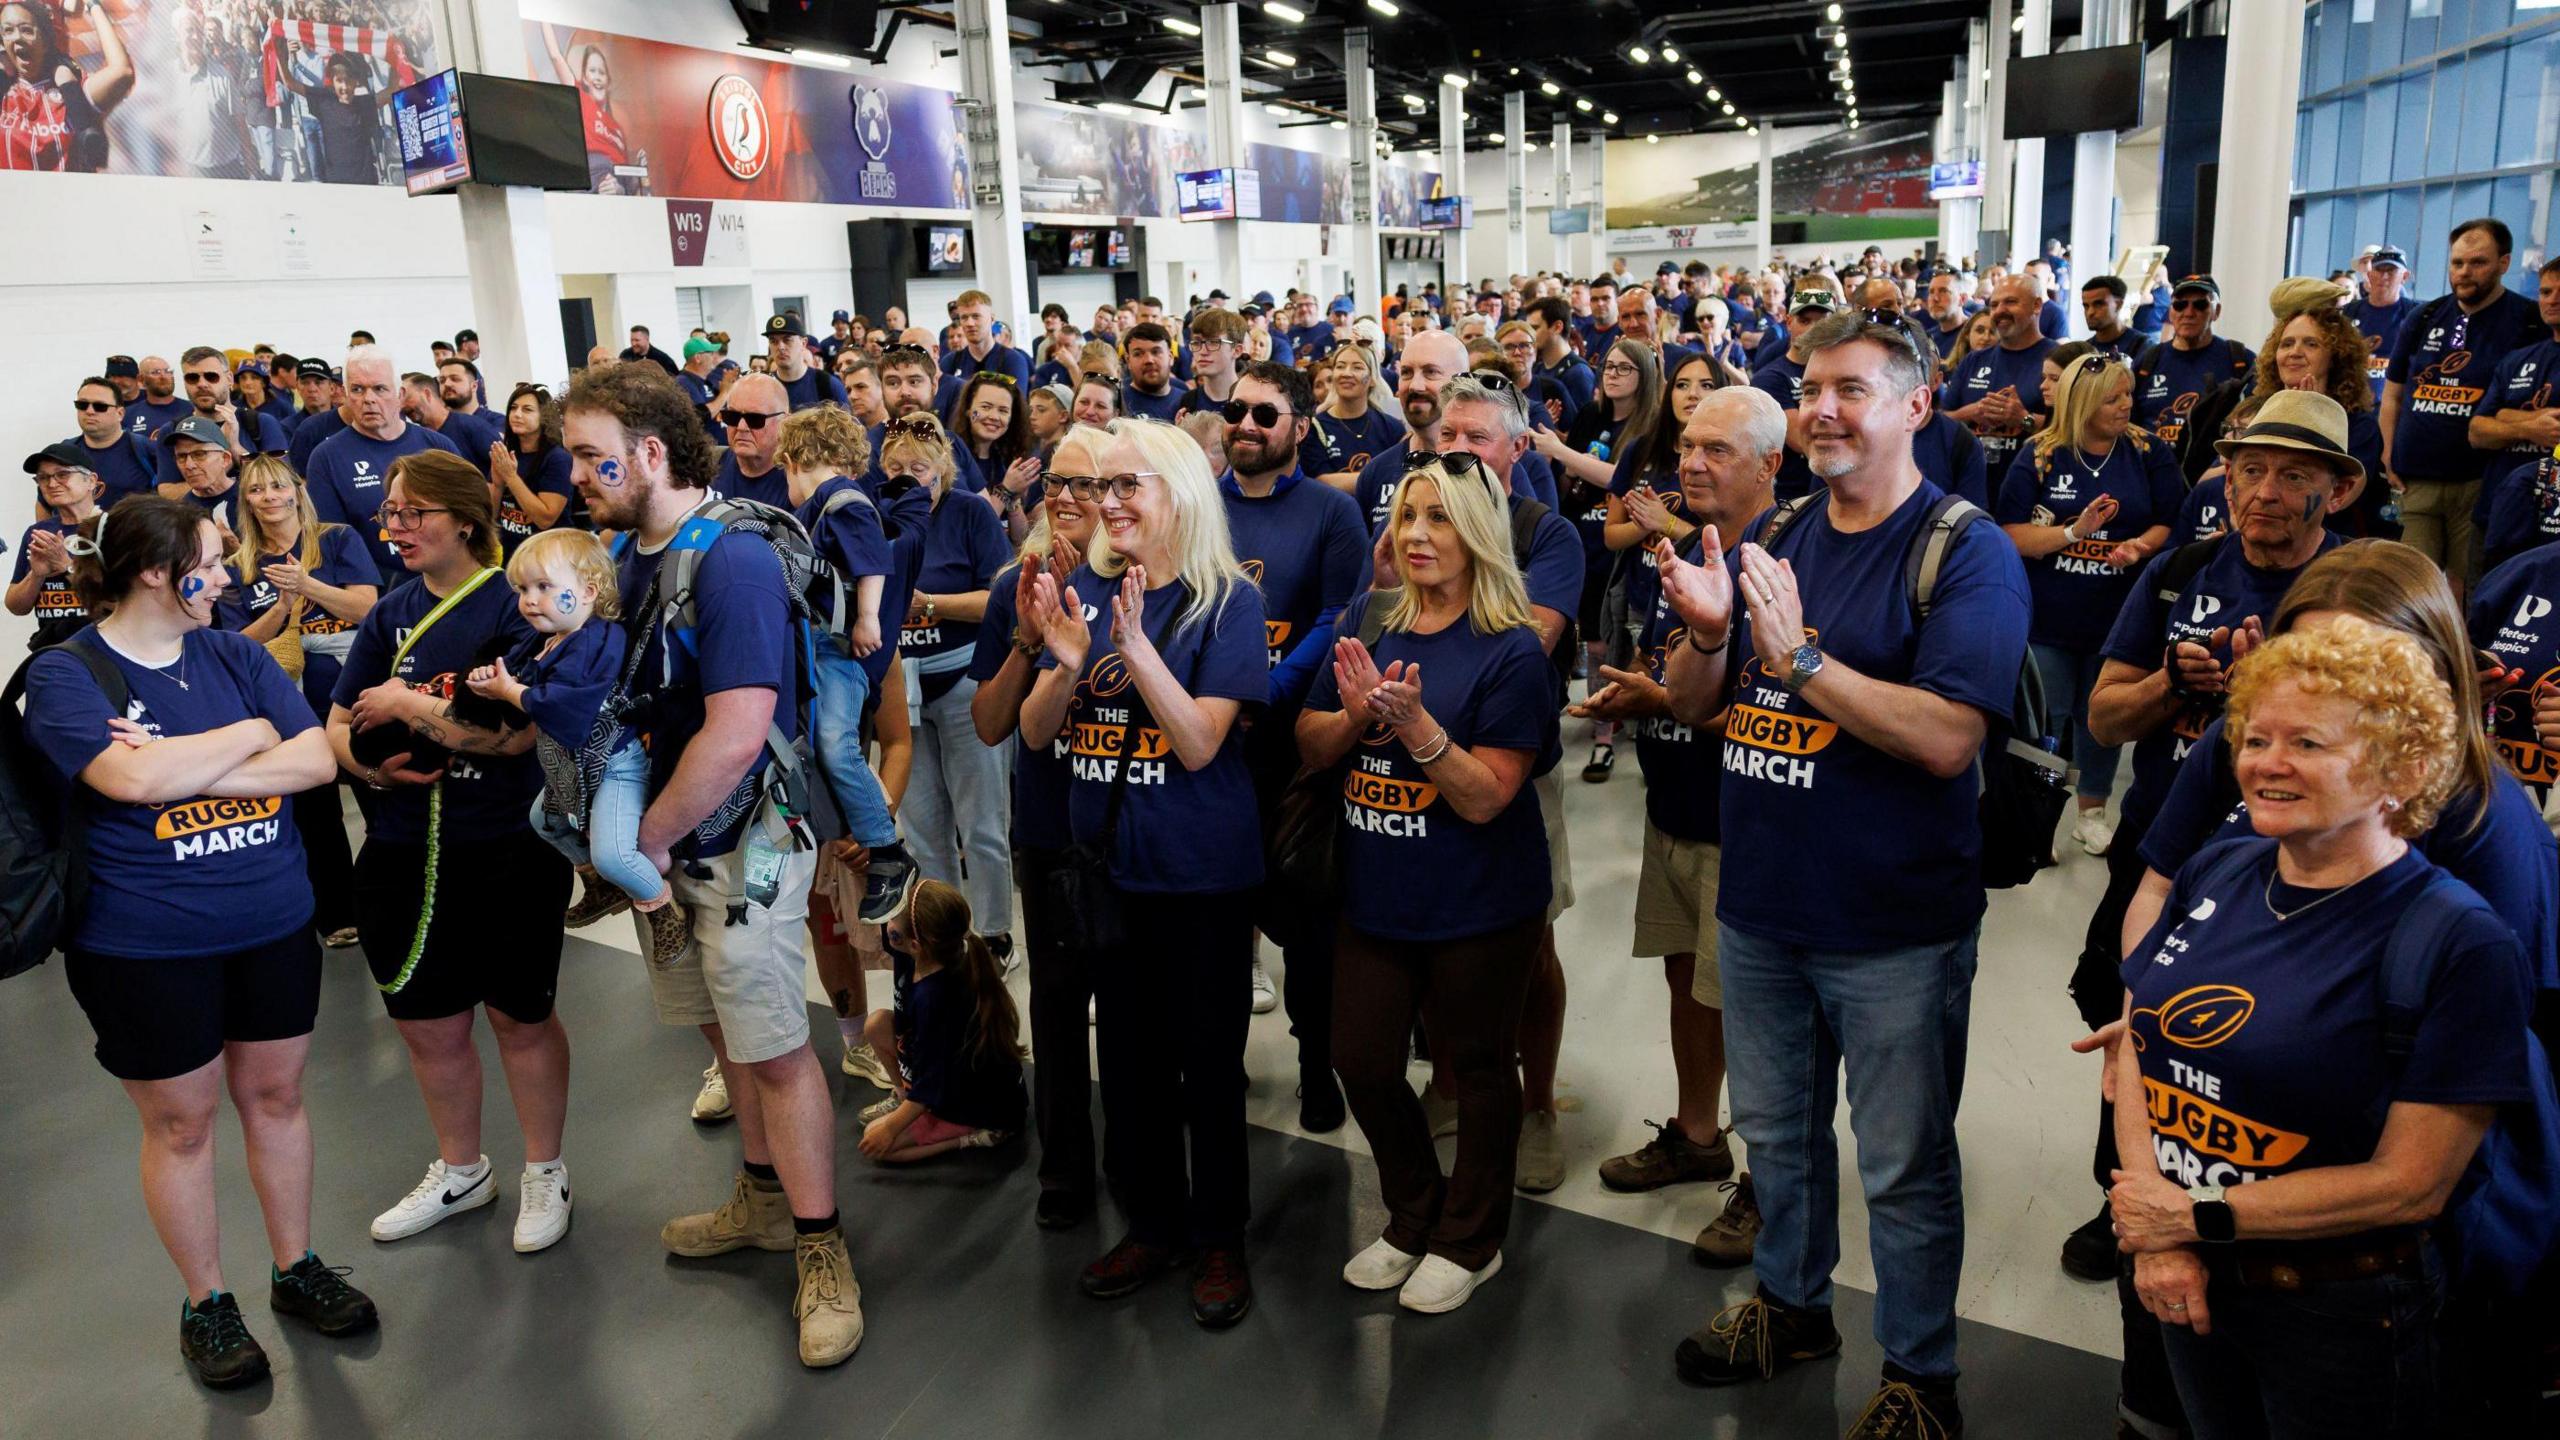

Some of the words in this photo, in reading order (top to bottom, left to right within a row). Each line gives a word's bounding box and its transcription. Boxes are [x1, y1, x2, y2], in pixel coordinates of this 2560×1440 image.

[734, 160, 757, 174] CITY
[860, 170, 897, 199] BEARS
[673, 212, 703, 232] W13
[718, 213, 745, 231] W14
[2440, 378, 2460, 387] THE
[2420, 386, 2474, 401] RUGBY
[2412, 399, 2473, 417] MARCH
[502, 518, 532, 535] ARCH
[44, 582, 66, 590] THE
[897, 628, 942, 646] RCH
[2181, 623, 2215, 637] Peter'
[2499, 627, 2540, 644] Peter's
[2490, 640, 2531, 655] Hospice
[1755, 687, 1790, 710] THE
[1094, 707, 1129, 723] THE
[1731, 708, 1819, 750] RUGBY
[1361, 755, 1393, 776] THE
[1722, 741, 1816, 789] MARCH
[168, 798, 271, 833] RUGBY
[173, 819, 279, 861] MARCH
[2168, 1057, 2221, 1101] THE
